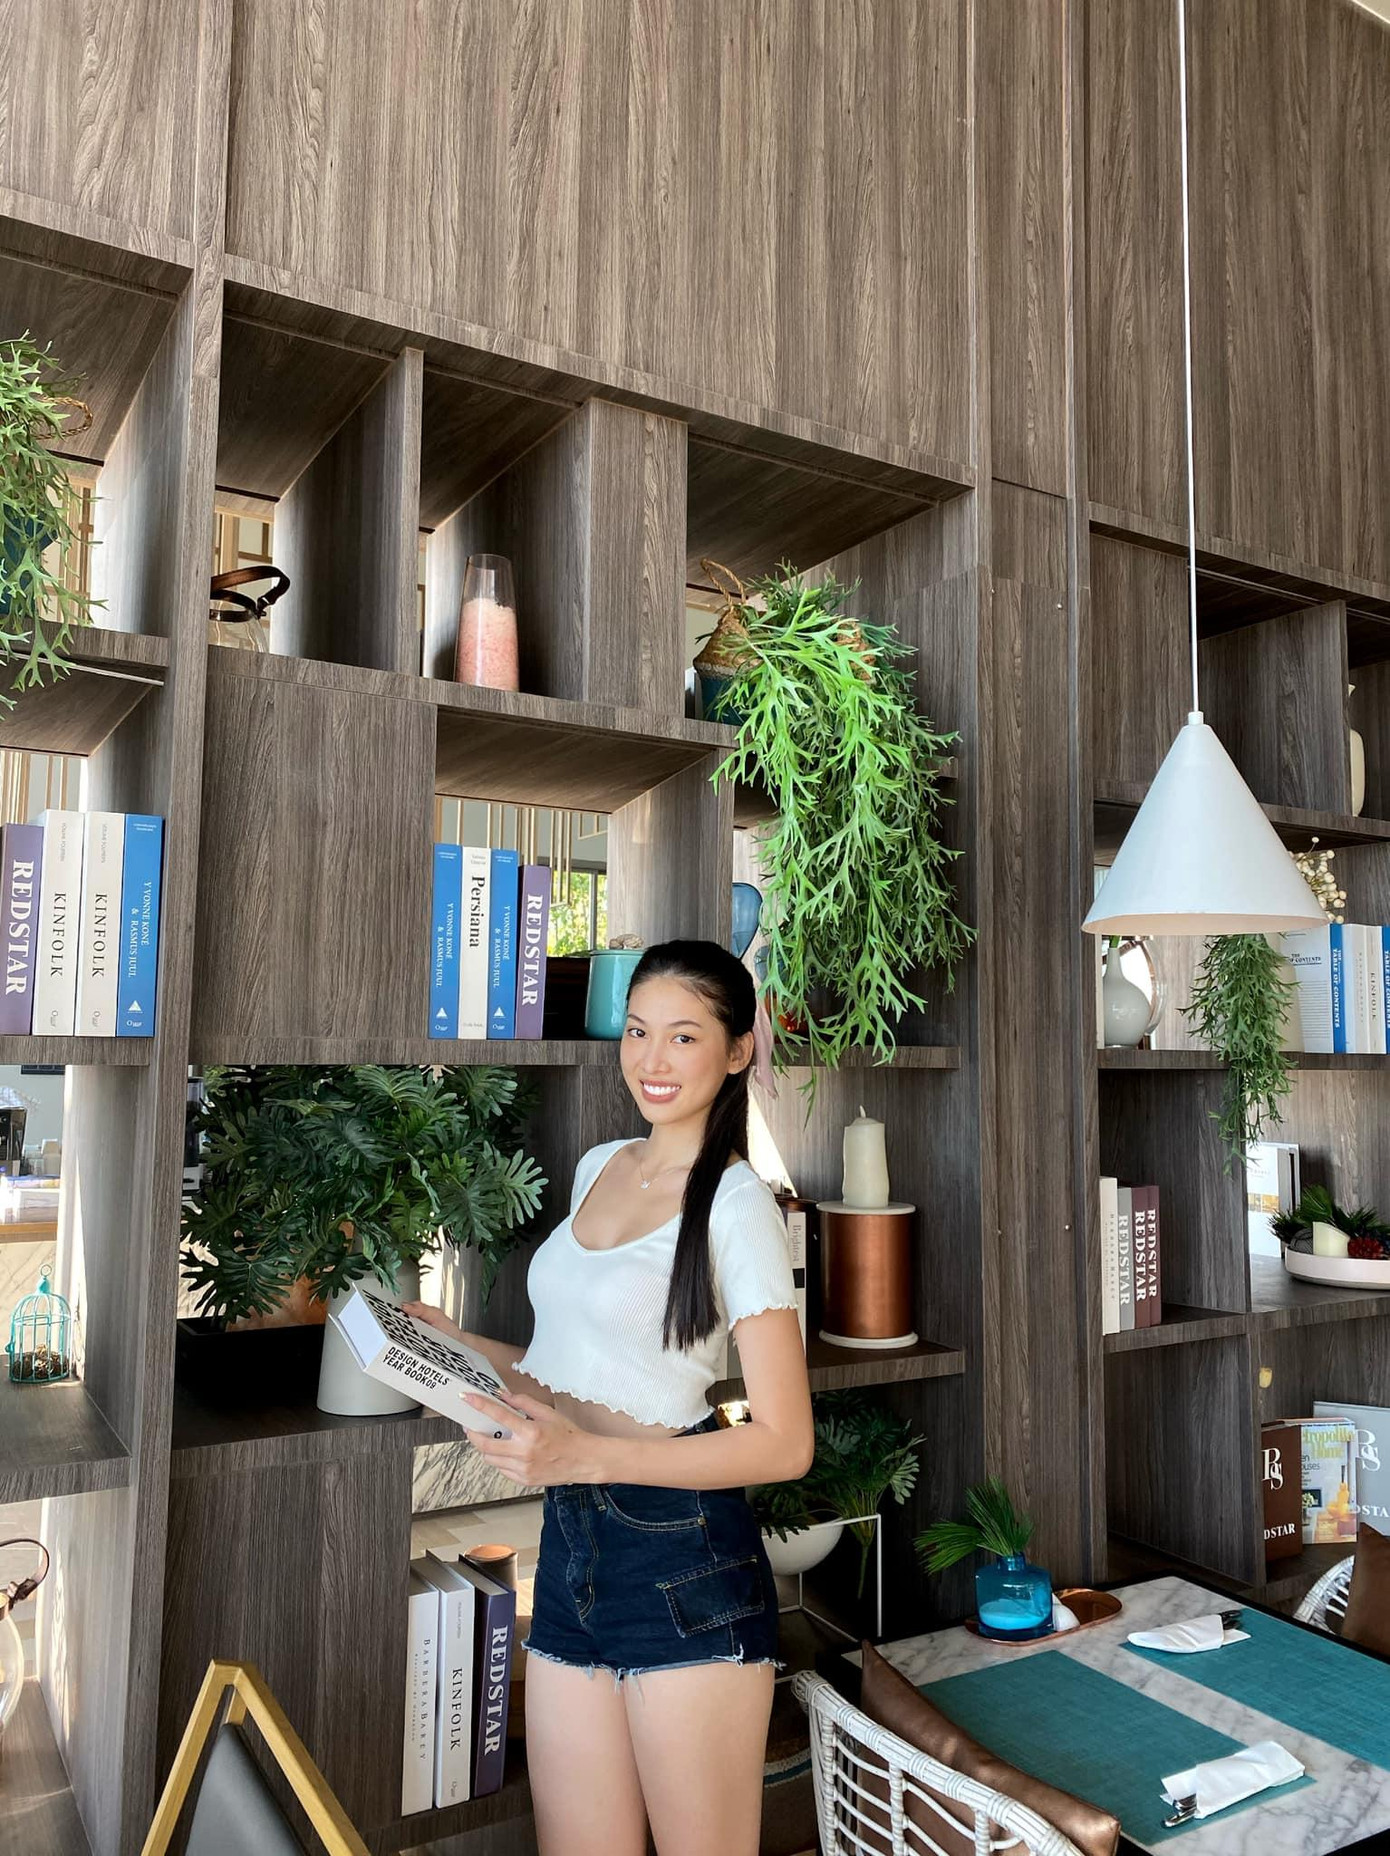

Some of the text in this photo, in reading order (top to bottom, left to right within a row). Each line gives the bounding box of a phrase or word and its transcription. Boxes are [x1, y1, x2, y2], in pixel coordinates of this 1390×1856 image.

[5, 860, 34, 995] REDSTAR
[50, 892, 66, 977] KINFOLK
[92, 893, 107, 978] KINFOLK
[128, 907, 139, 978] & RASMUS JUUL
[469, 875, 486, 948] Persiana
[521, 894, 543, 1006] REDSTAR
[1119, 1215, 1130, 1305] REDSTAR
[1135, 1211, 1146, 1301] REDSTAR
[1147, 1209, 1157, 1297] REDSTAR
[383, 1354, 405, 1371] YEAR
[388, 1346, 450, 1386] DESIGN HOTELS
[1263, 1523, 1296, 1540] DSTAR
[450, 1668, 463, 1751] KINFOLK
[484, 1625, 508, 1757] REDSTAR
